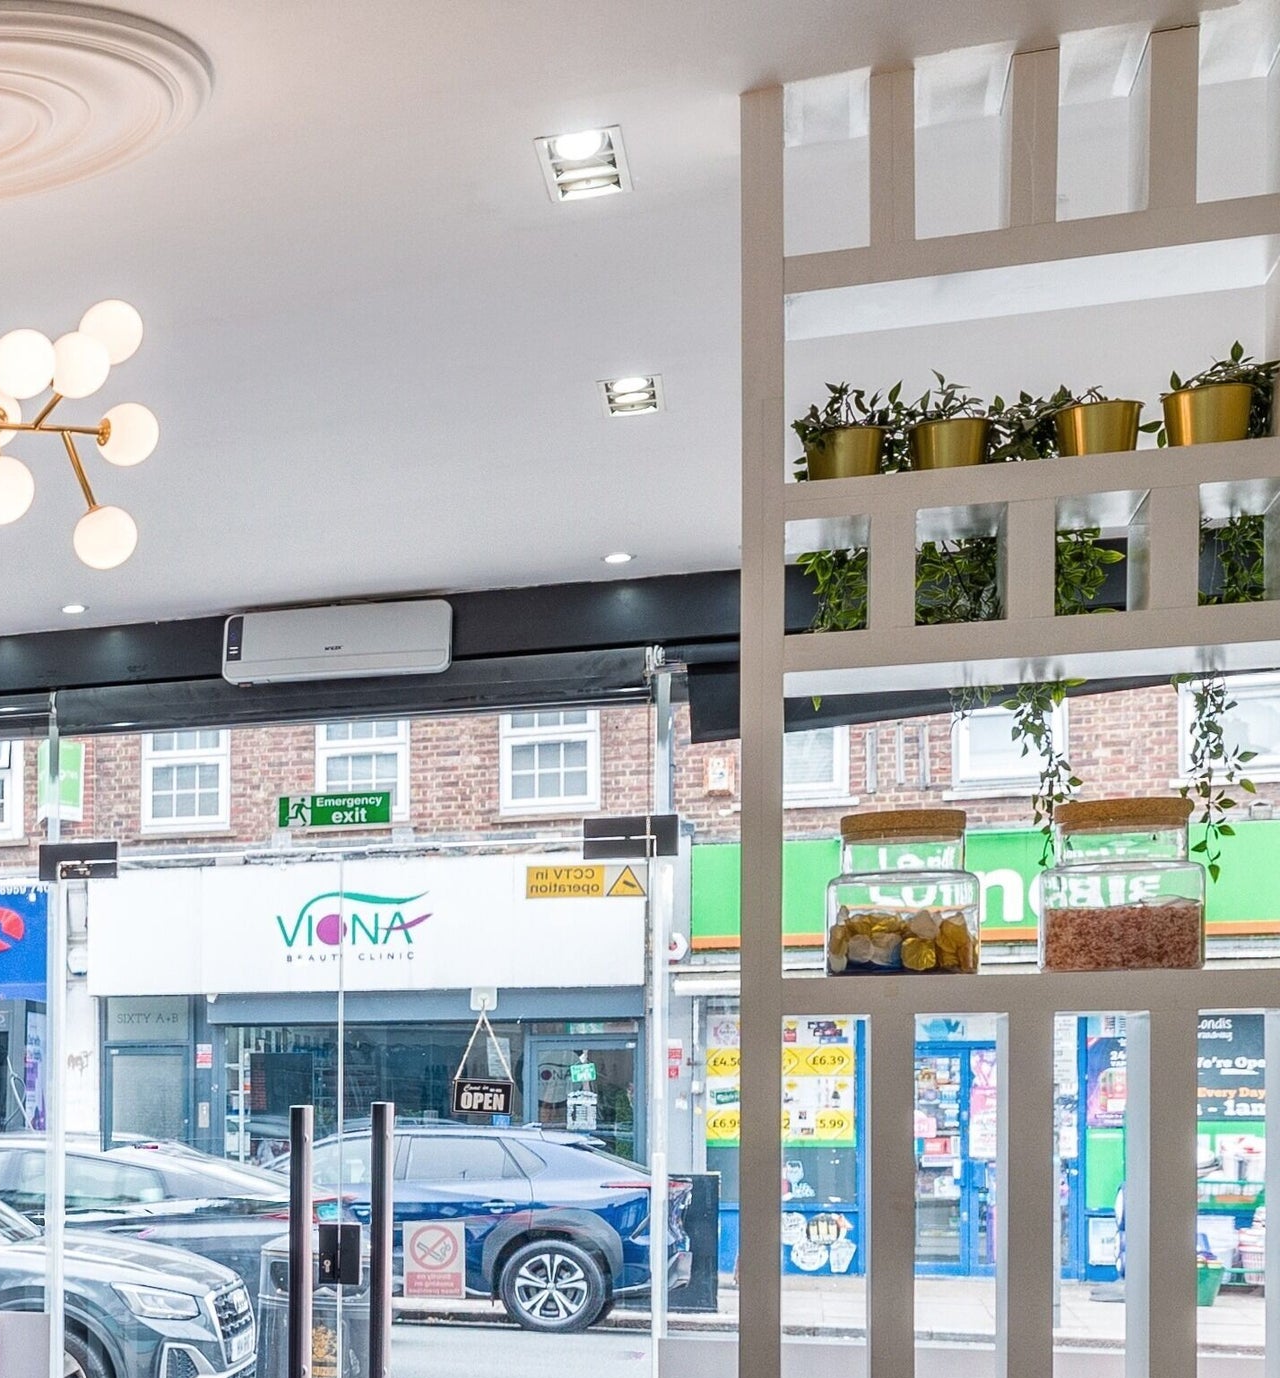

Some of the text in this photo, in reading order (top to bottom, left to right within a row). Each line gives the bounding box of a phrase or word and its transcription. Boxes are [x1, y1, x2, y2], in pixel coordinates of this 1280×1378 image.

[316, 796, 382, 808] Emergency
[331, 807, 367, 823] exit
[276, 908, 432, 948] VIONA
[358, 951, 415, 962] CLINIC
[117, 1013, 151, 1024] SIXTY
[812, 1055, 844, 1066] £6.39
[1234, 1056, 1266, 1070] Ope
[460, 1091, 505, 1111] OPEN
